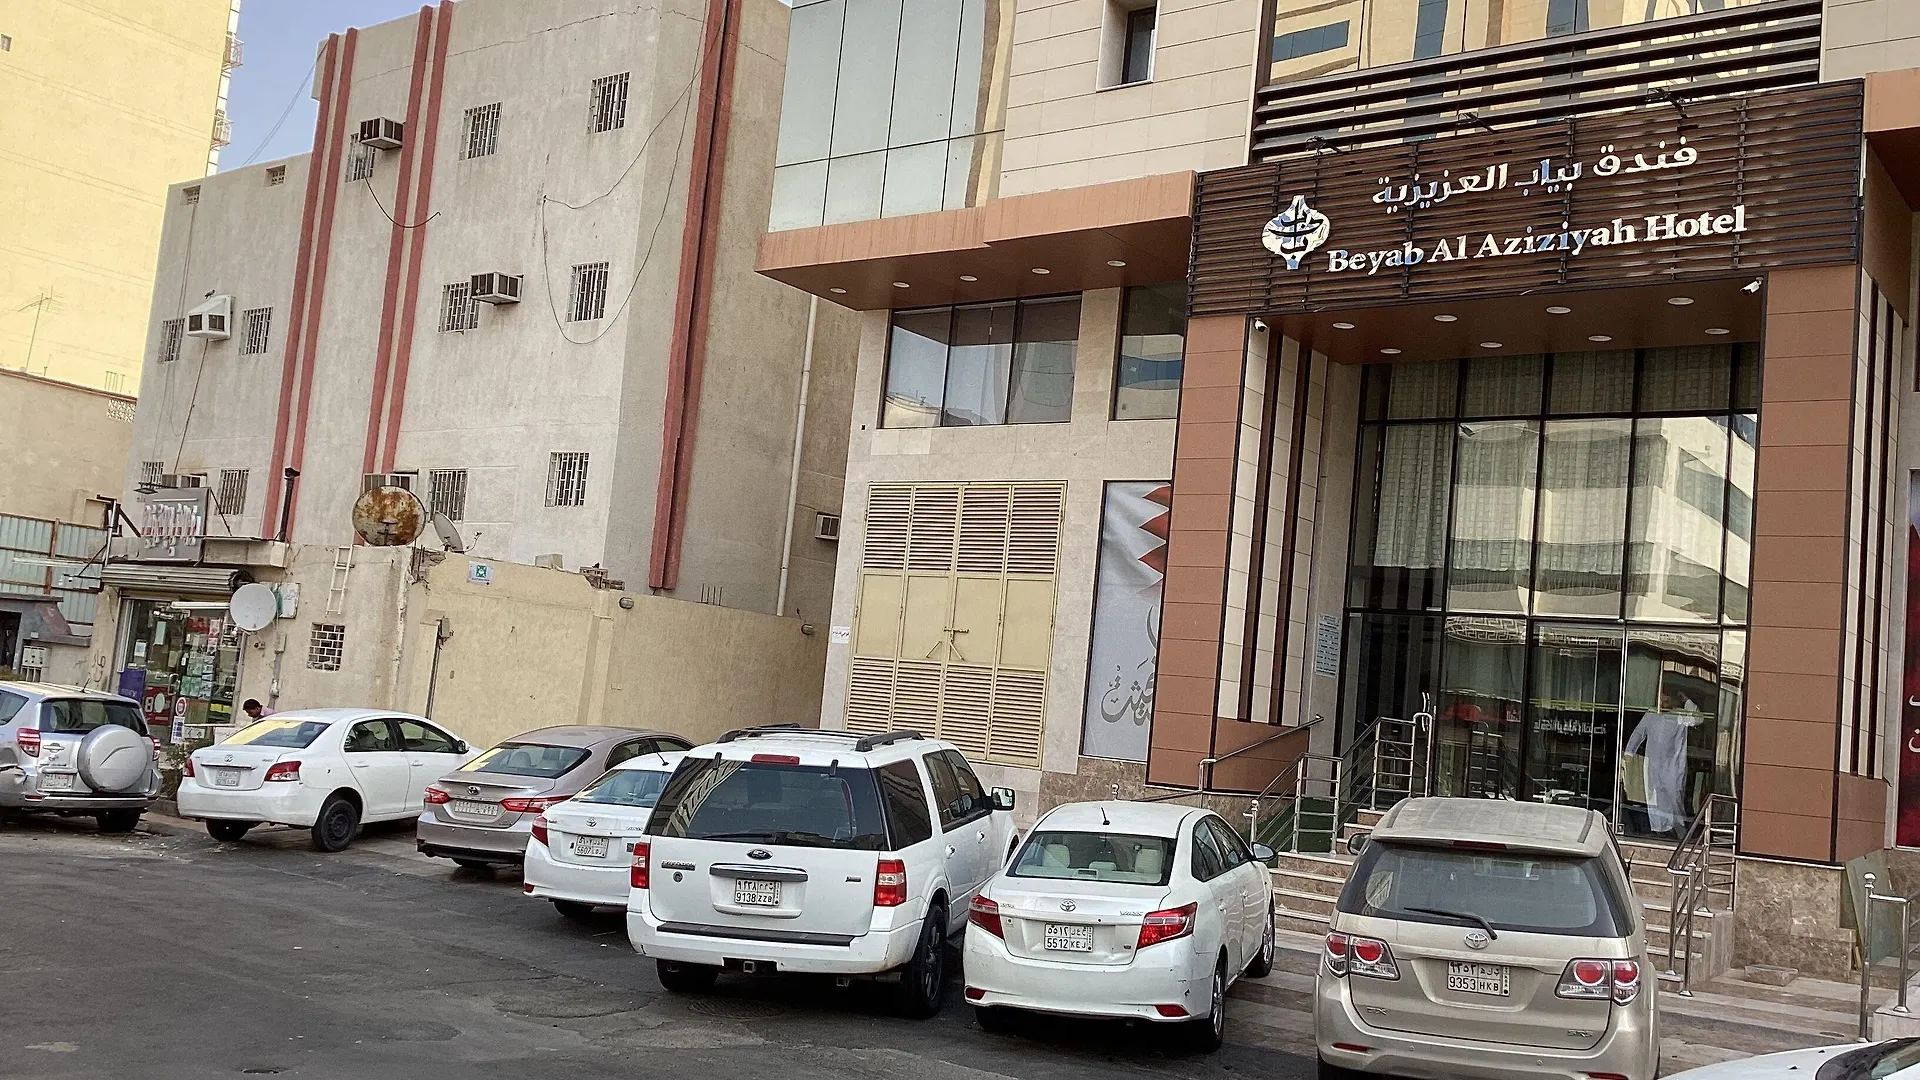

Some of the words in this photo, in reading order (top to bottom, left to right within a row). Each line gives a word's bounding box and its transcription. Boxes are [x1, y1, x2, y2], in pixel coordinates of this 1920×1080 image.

[1593, 136, 1698, 176] فندق
[1372, 163, 1509, 214] العزيزية
[1514, 159, 1583, 197] بياب
[1326, 241, 1425, 275] Beyab
[1427, 234, 1468, 263] Al
[1473, 218, 1639, 259] Aziziyah
[1643, 204, 1748, 242] Hotel
[736, 892, 757, 903] 9138
[758, 894, 773, 903] ZZB
[1047, 937, 1069, 949] 5512
[1071, 940, 1086, 949] KEJ
[1449, 976, 1477, 991] 9353
[1479, 981, 1499, 992] HKB
